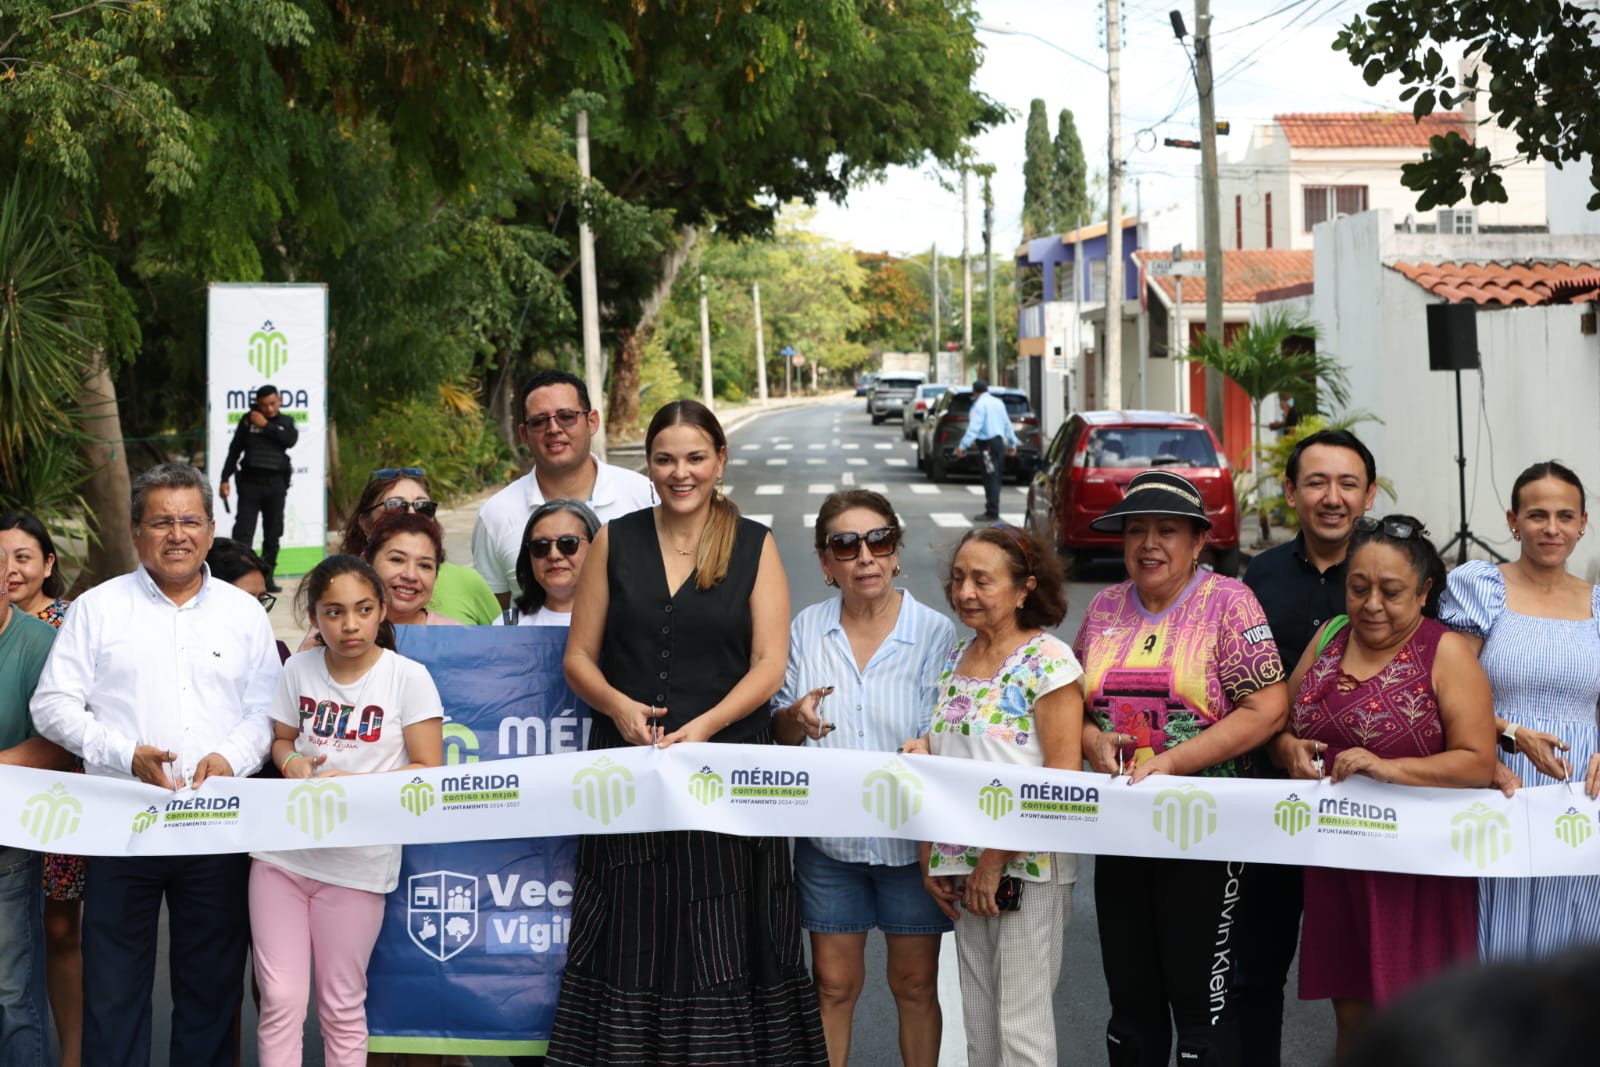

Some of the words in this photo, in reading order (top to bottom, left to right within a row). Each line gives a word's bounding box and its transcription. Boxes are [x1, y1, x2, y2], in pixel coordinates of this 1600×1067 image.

[227, 386, 308, 409] MÉDA
[298, 695, 384, 743] POLO
[498, 709, 592, 755] MÉ
[441, 773, 519, 792] MÉRIDA
[731, 767, 809, 786] MÉRIDA
[444, 793, 478, 801] CONTIGO
[492, 791, 517, 799] MEJOR
[1020, 781, 1099, 802] MÉRIDA
[167, 811, 199, 820] CONTIGO
[442, 803, 489, 811] AYUNTAMIENTO
[1022, 802, 1057, 810] CONTIGO
[1071, 804, 1097, 813] MEJOR
[1318, 797, 1397, 821] MÉRIDA
[1067, 815, 1099, 823] 2024-2027
[1320, 817, 1356, 826] CONTIGO
[1317, 828, 1366, 836] AYUNTAMIENTO
[486, 874, 574, 907] Vec
[493, 915, 571, 953] Vigil
[1210, 949, 1231, 1012] Klein
